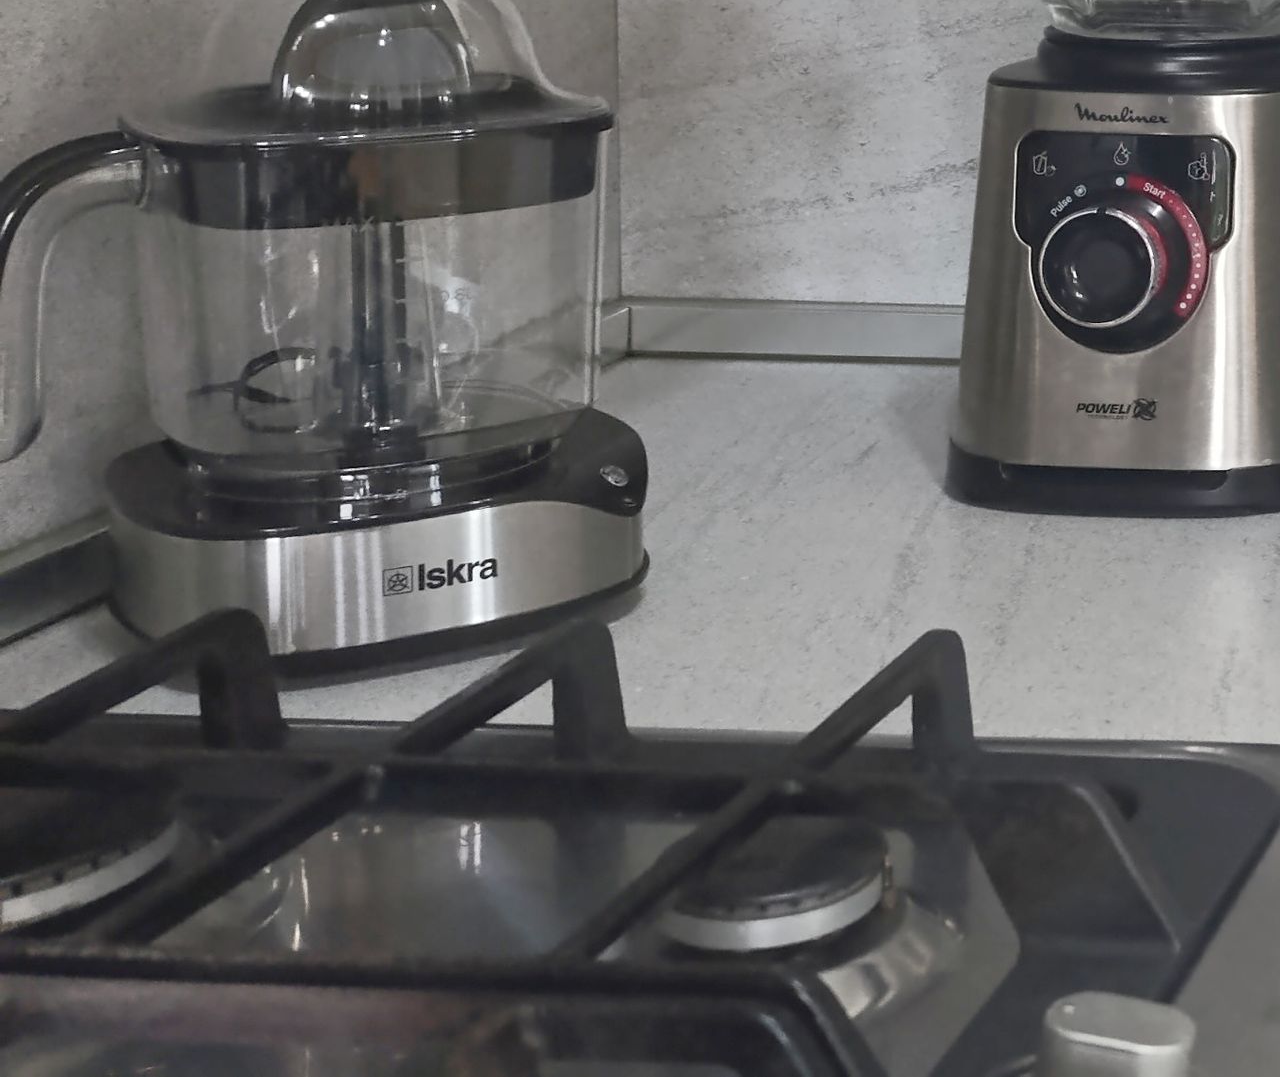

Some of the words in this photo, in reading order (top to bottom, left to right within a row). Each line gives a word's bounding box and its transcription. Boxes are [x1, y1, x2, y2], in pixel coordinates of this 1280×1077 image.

[1074, 102, 1170, 124] Moulinex
[1142, 181, 1167, 200] Start
[1050, 195, 1073, 218] Pulse
[418, 557, 499, 591] Iskra
